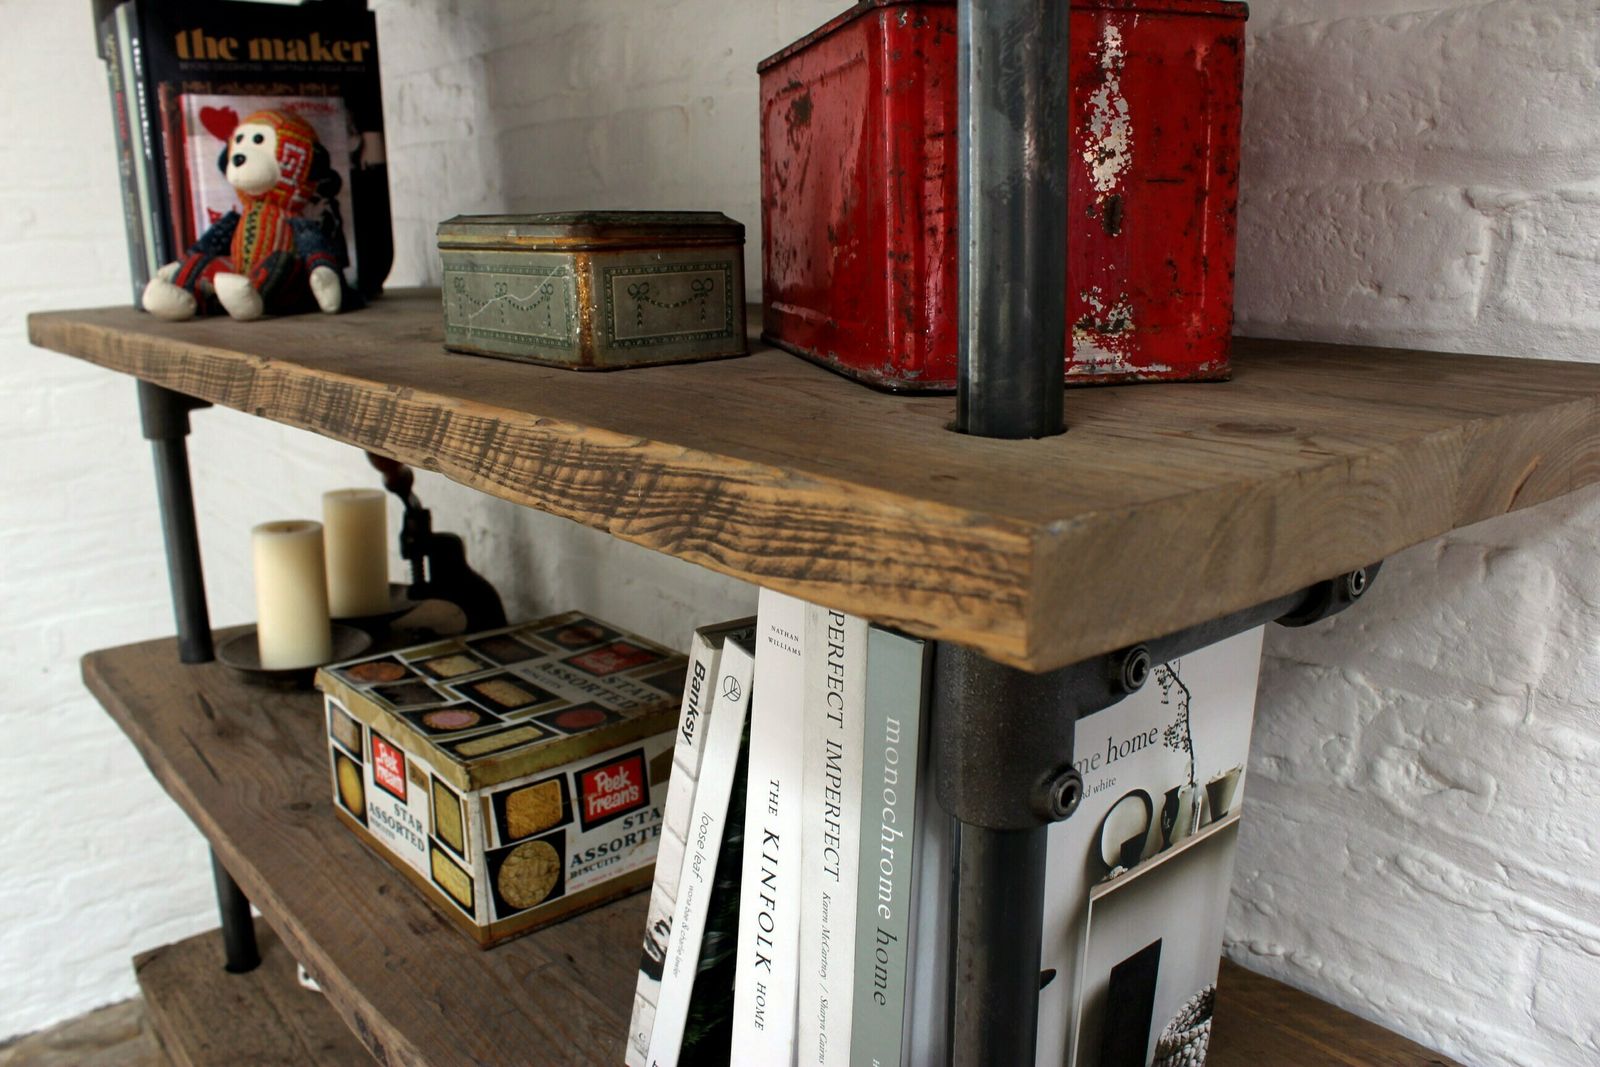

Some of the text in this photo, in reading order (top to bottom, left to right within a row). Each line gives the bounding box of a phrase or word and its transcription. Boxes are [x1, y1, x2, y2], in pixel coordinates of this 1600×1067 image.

[174, 28, 370, 63] the maker
[768, 636, 801, 657] WILLIAMS
[770, 624, 800, 643] NATHAN
[681, 659, 707, 746] Banksy
[823, 609, 846, 882] PERFECT IMPERFECT
[1073, 727, 1158, 775] me home
[594, 765, 632, 796] Peek
[1093, 777, 1117, 795] white
[587, 784, 640, 817] Frean's
[622, 804, 665, 831] STA
[369, 801, 426, 852] ASSORTED
[393, 803, 424, 835] STAR
[570, 822, 662, 869] ASSORTE
[692, 811, 715, 884] loose leaf
[873, 716, 904, 1007] monochrome home
[754, 779, 780, 1031] THE KINFOLK HOME
[821, 891, 832, 924] Karen
[818, 925, 831, 981] McCartney
[816, 995, 829, 1031] Sharyn
[818, 1032, 829, 1066] Cairns
